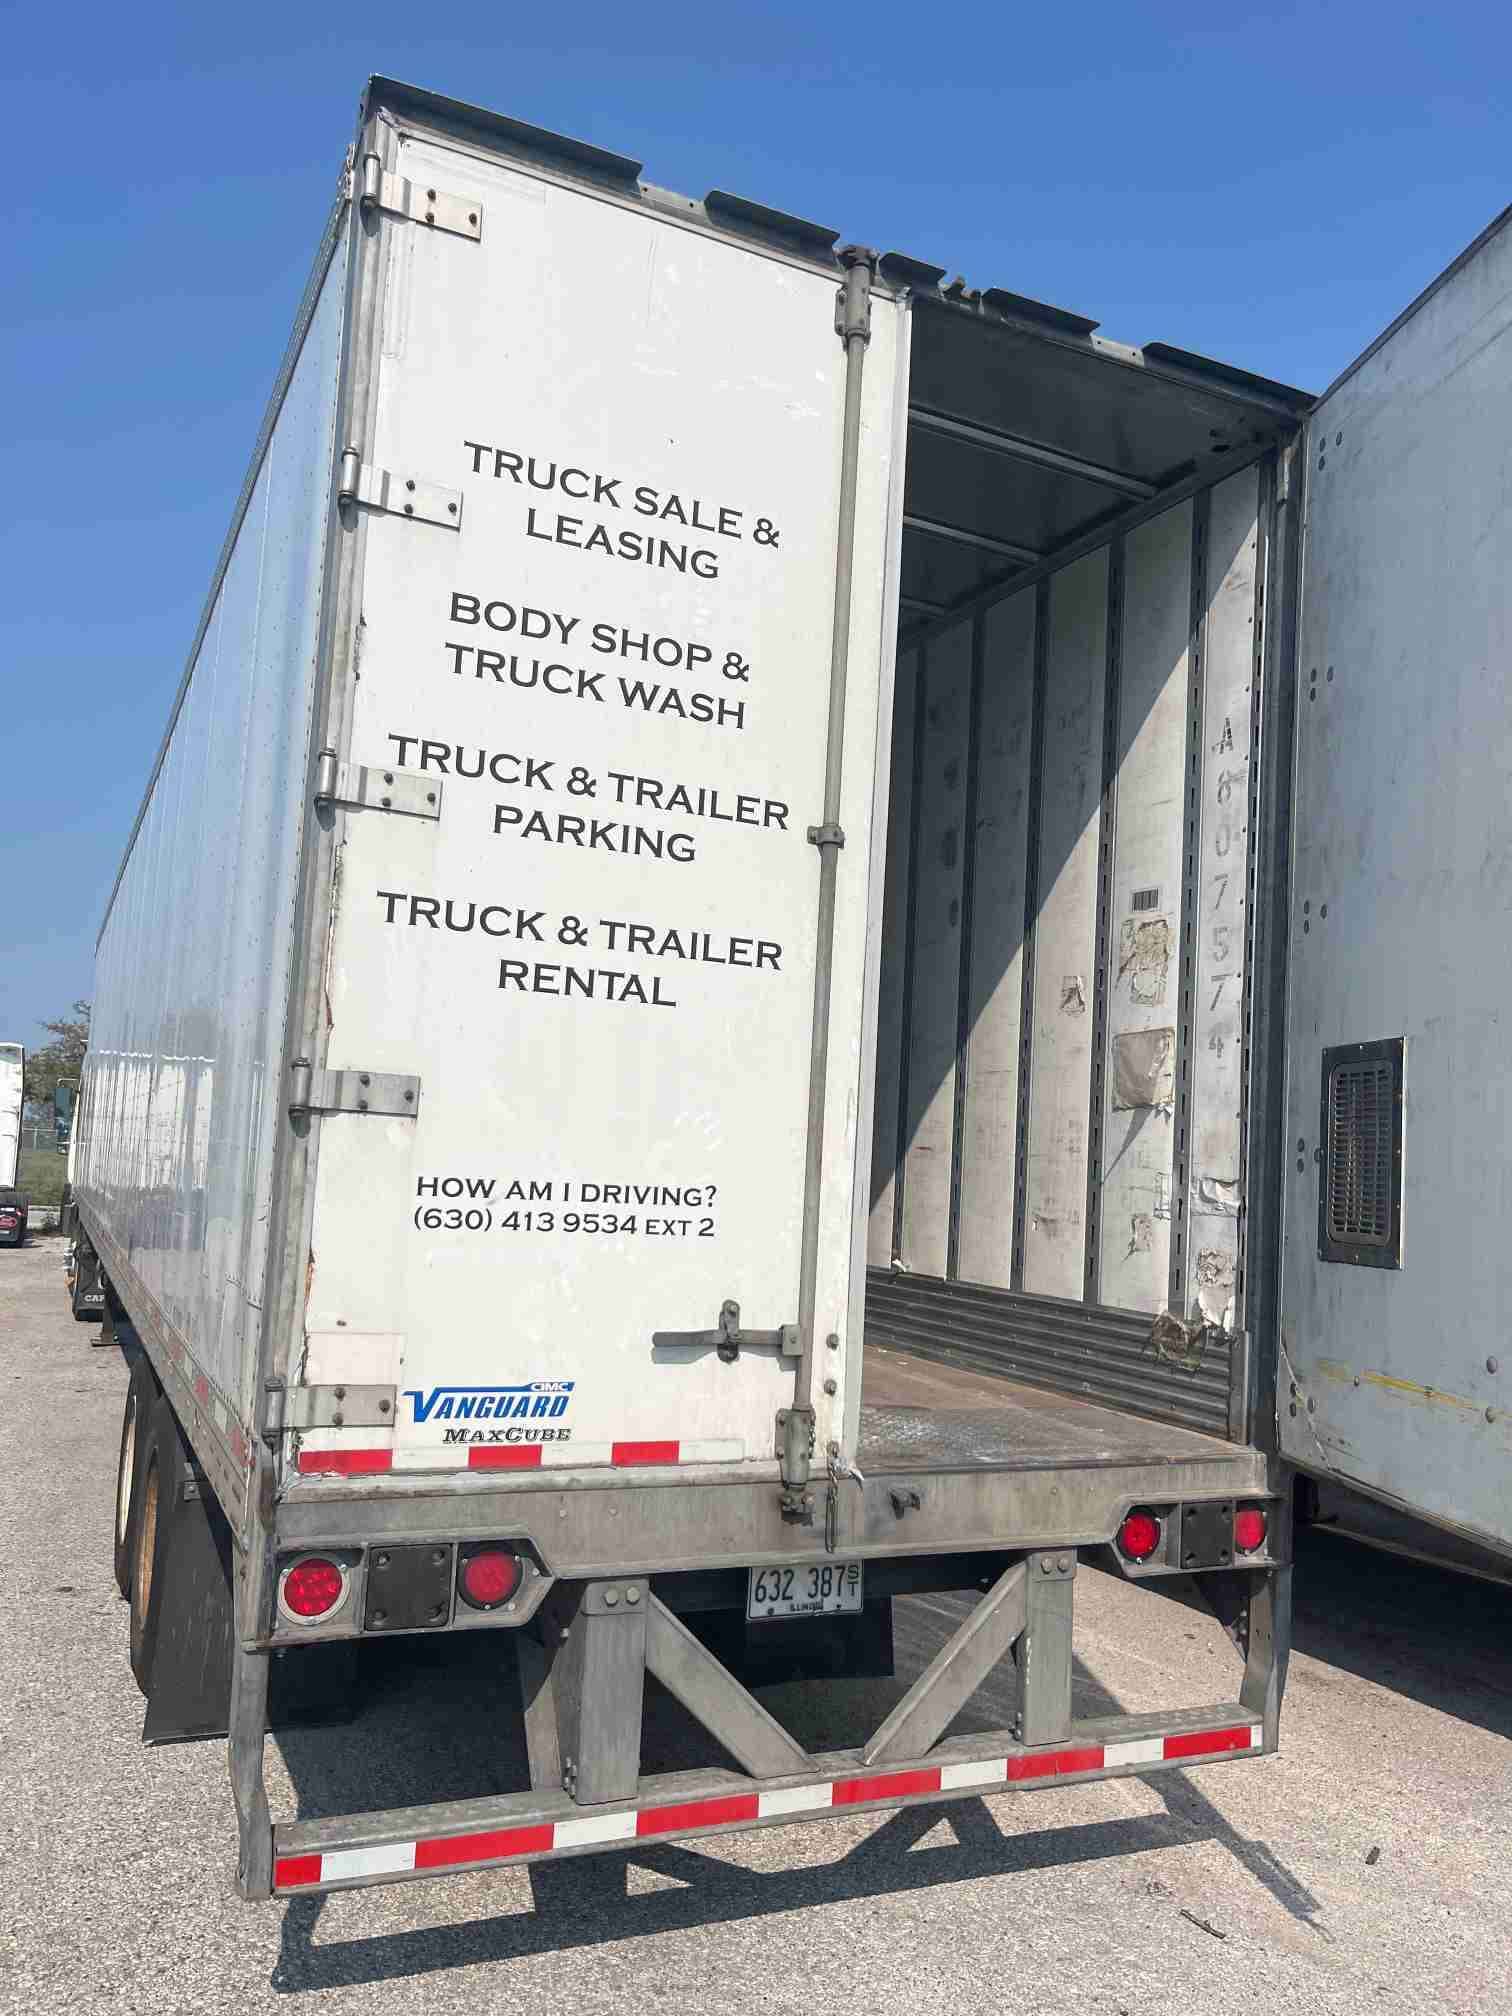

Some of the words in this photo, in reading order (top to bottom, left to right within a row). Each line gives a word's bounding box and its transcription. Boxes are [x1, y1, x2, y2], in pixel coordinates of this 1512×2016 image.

[463, 440, 621, 508] TRUCK
[633, 486, 743, 540] SALE
[752, 517, 780, 549] &
[526, 507, 720, 579] LEASING
[450, 591, 581, 645] BODY
[591, 623, 713, 671] SHOP
[722, 651, 750, 682] &
[445, 641, 606, 702] TRUCK
[617, 677, 746, 730] WASH
[388, 733, 556, 791] TRUCK
[566, 766, 597, 798] &
[607, 771, 790, 831] TRAILER
[493, 804, 697, 862] PARKING
[376, 890, 546, 942] TRUCK
[557, 915, 588, 946] &
[600, 919, 783, 971] TRAILER
[498, 959, 677, 1008] RENTAL
[416, 1176, 497, 1199] HOW
[504, 1180, 553, 1202] AM
[562, 1182, 571, 1203] I
[580, 1183, 718, 1209] DRIVING?
[413, 1207, 493, 1232] (630)
[501, 1210, 555, 1233] 413
[562, 1212, 638, 1235] 9534
[645, 1218, 693, 1237] EXT
[698, 1217, 716, 1238] 2
[401, 1386, 570, 1424] VANGUARD
[529, 1381, 571, 1392] CIMC
[755, 1569, 795, 1603] 632
[808, 1565, 846, 1599] 387
